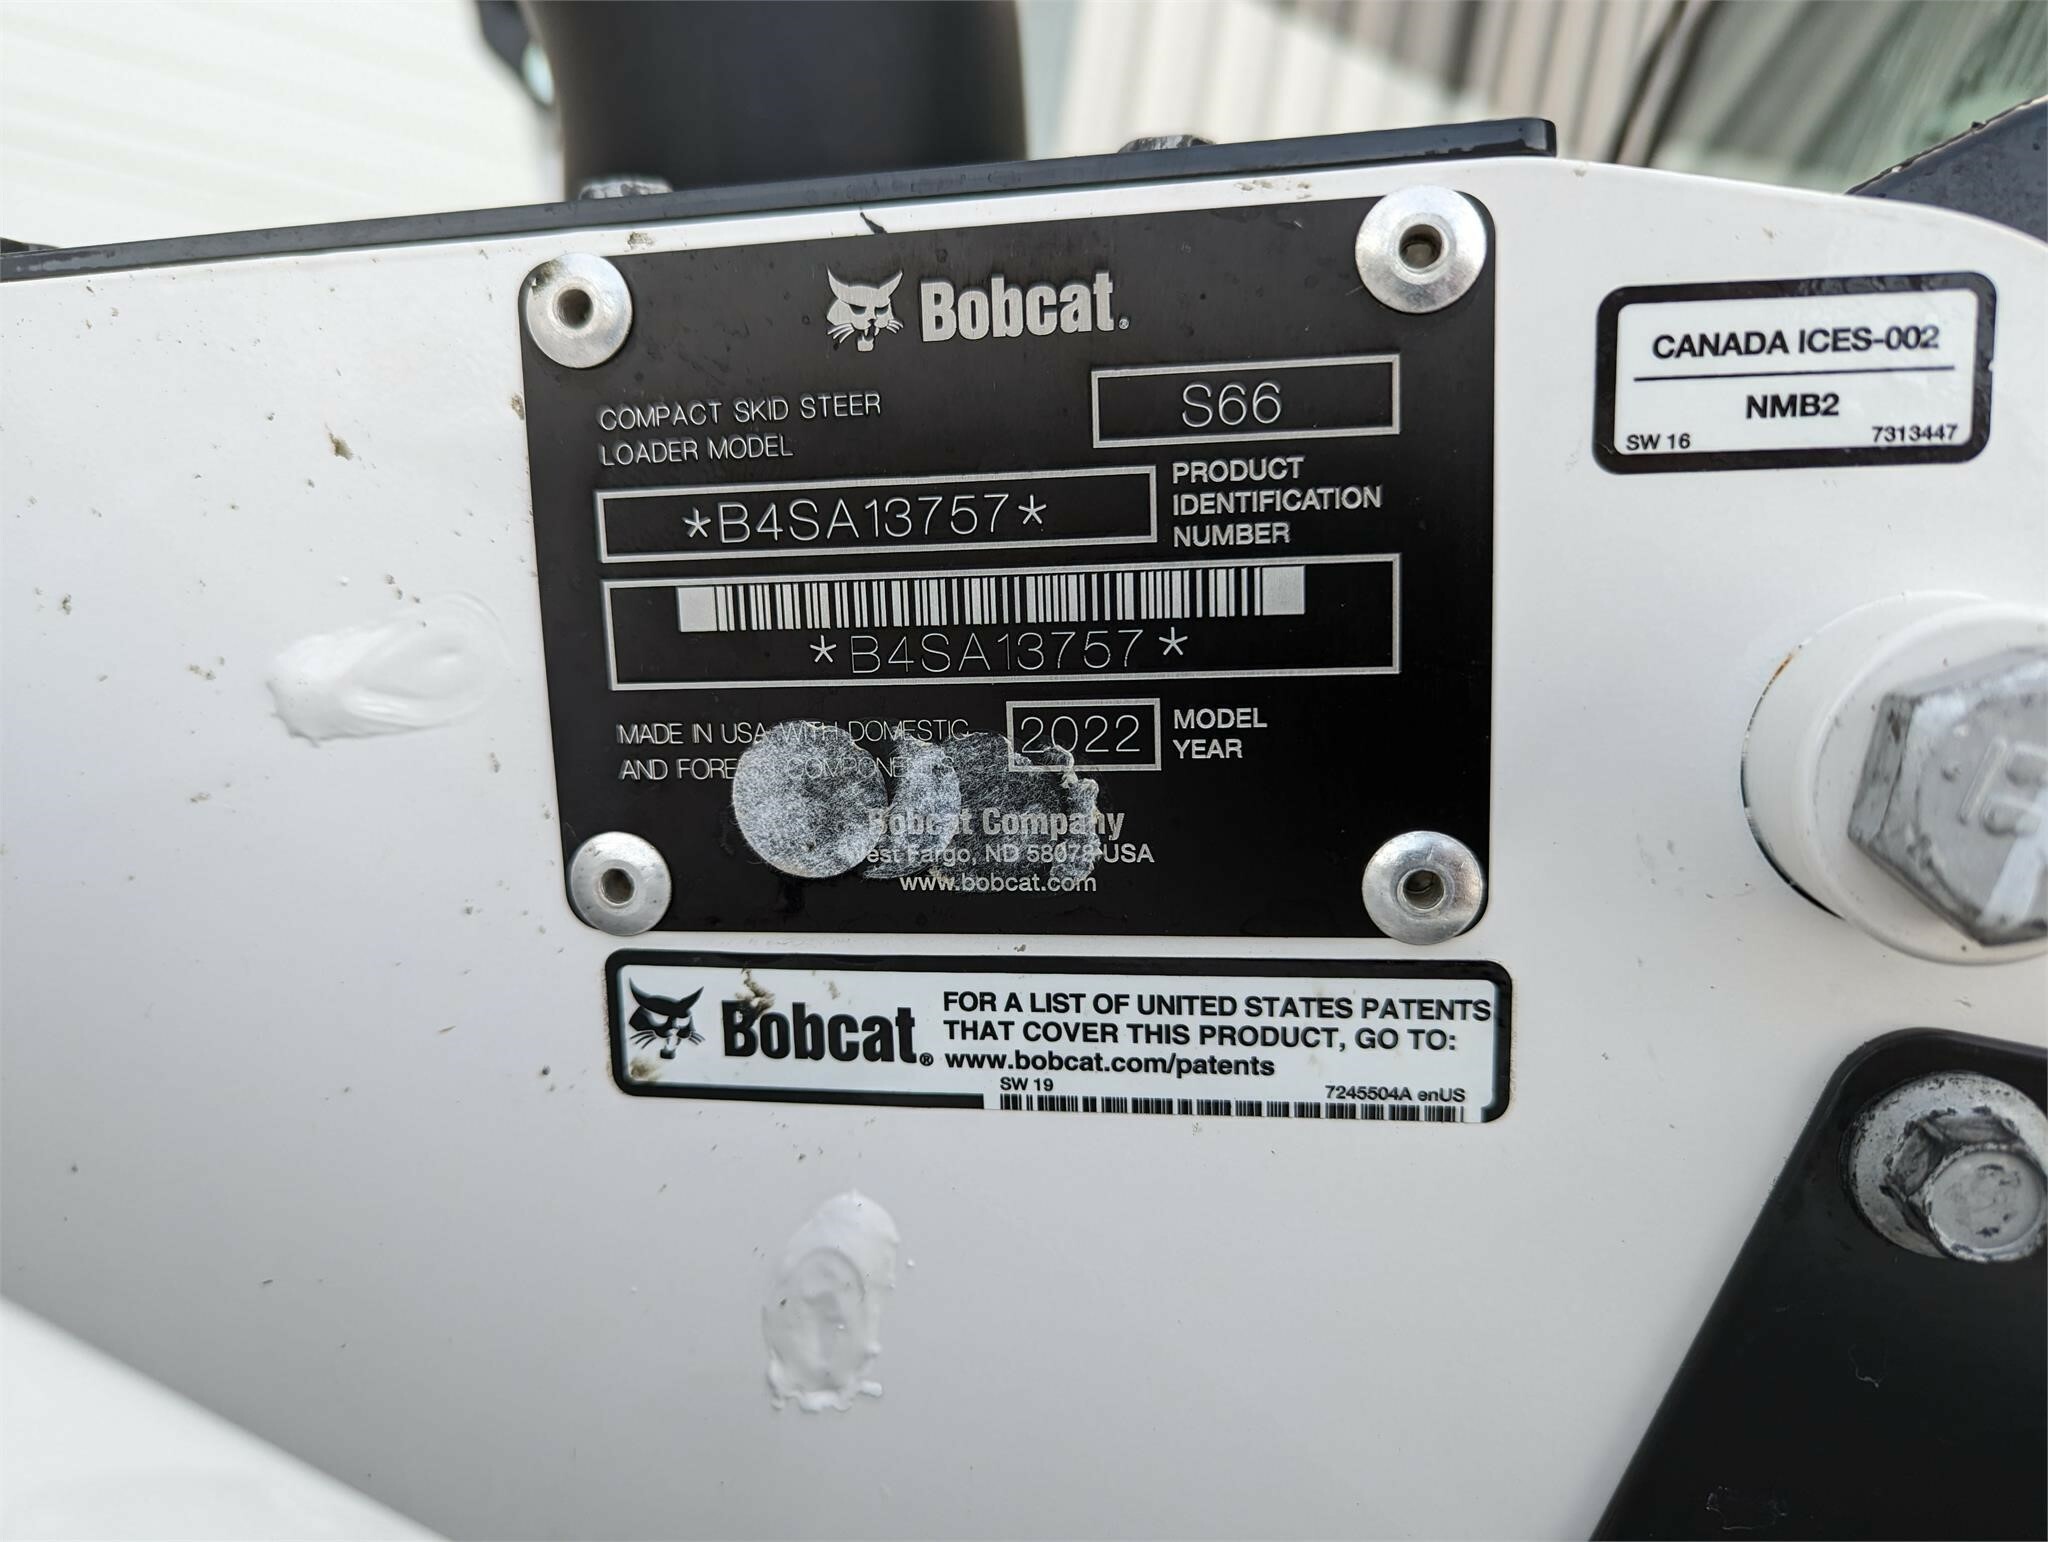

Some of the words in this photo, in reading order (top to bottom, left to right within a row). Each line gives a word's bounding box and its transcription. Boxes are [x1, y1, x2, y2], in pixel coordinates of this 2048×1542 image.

[1652, 329, 1790, 359] CANADA
[1799, 325, 1941, 354] ICES-002
[601, 400, 722, 431] COMPACT
[735, 397, 789, 423] SKID
[801, 393, 881, 419] STEER
[1182, 382, 1283, 428] S66
[1745, 393, 1840, 420] NMB2
[1626, 434, 1662, 451] SW
[1667, 433, 1692, 450] 16
[1871, 423, 1959, 443] 7313447
[601, 439, 699, 466] LOADER
[708, 434, 793, 461] MODEL
[1173, 456, 1305, 484] PRODUCT
[1173, 486, 1381, 516] IDENTIFICATION
[1173, 522, 1290, 547] NUMBER
[616, 722, 684, 744] MADE
[692, 722, 713, 743] IN
[721, 721, 768, 744] USA
[849, 718, 969, 742] DOMESTIC
[1173, 707, 1268, 730] MODEL
[1020, 714, 1141, 753] 2022
[1173, 738, 1243, 760] YEAR
[619, 758, 668, 780] AND
[982, 807, 1126, 841] Company
[908, 845, 977, 867] Fargo,
[986, 843, 1019, 863] ND
[1103, 843, 1155, 864] USA
[900, 873, 1097, 892] www.bobcat.com
[943, 991, 997, 1012] FOR
[1004, 992, 1024, 1012] A
[1030, 993, 1086, 1014] LIST
[1093, 993, 1130, 1015] OF
[1137, 994, 1238, 1017] UNITED
[1244, 996, 1354, 1020] STATES
[1361, 998, 1491, 1022] PATENTS
[943, 1020, 1015, 1041] THAT
[1022, 1021, 1119, 1043] COVER
[1126, 1023, 1191, 1045] THIS
[1200, 1025, 1346, 1052] PRODUCT,
[1355, 1028, 1399, 1050] GO
[1409, 1029, 1457, 1051] TO:
[945, 1050, 1275, 1079] www.bobcat.com/patents
[1000, 1077, 1028, 1091] SW
[1034, 1078, 1054, 1091] 19
[1325, 1084, 1412, 1102] 7245504A
[1418, 1087, 1466, 1102] enUS
